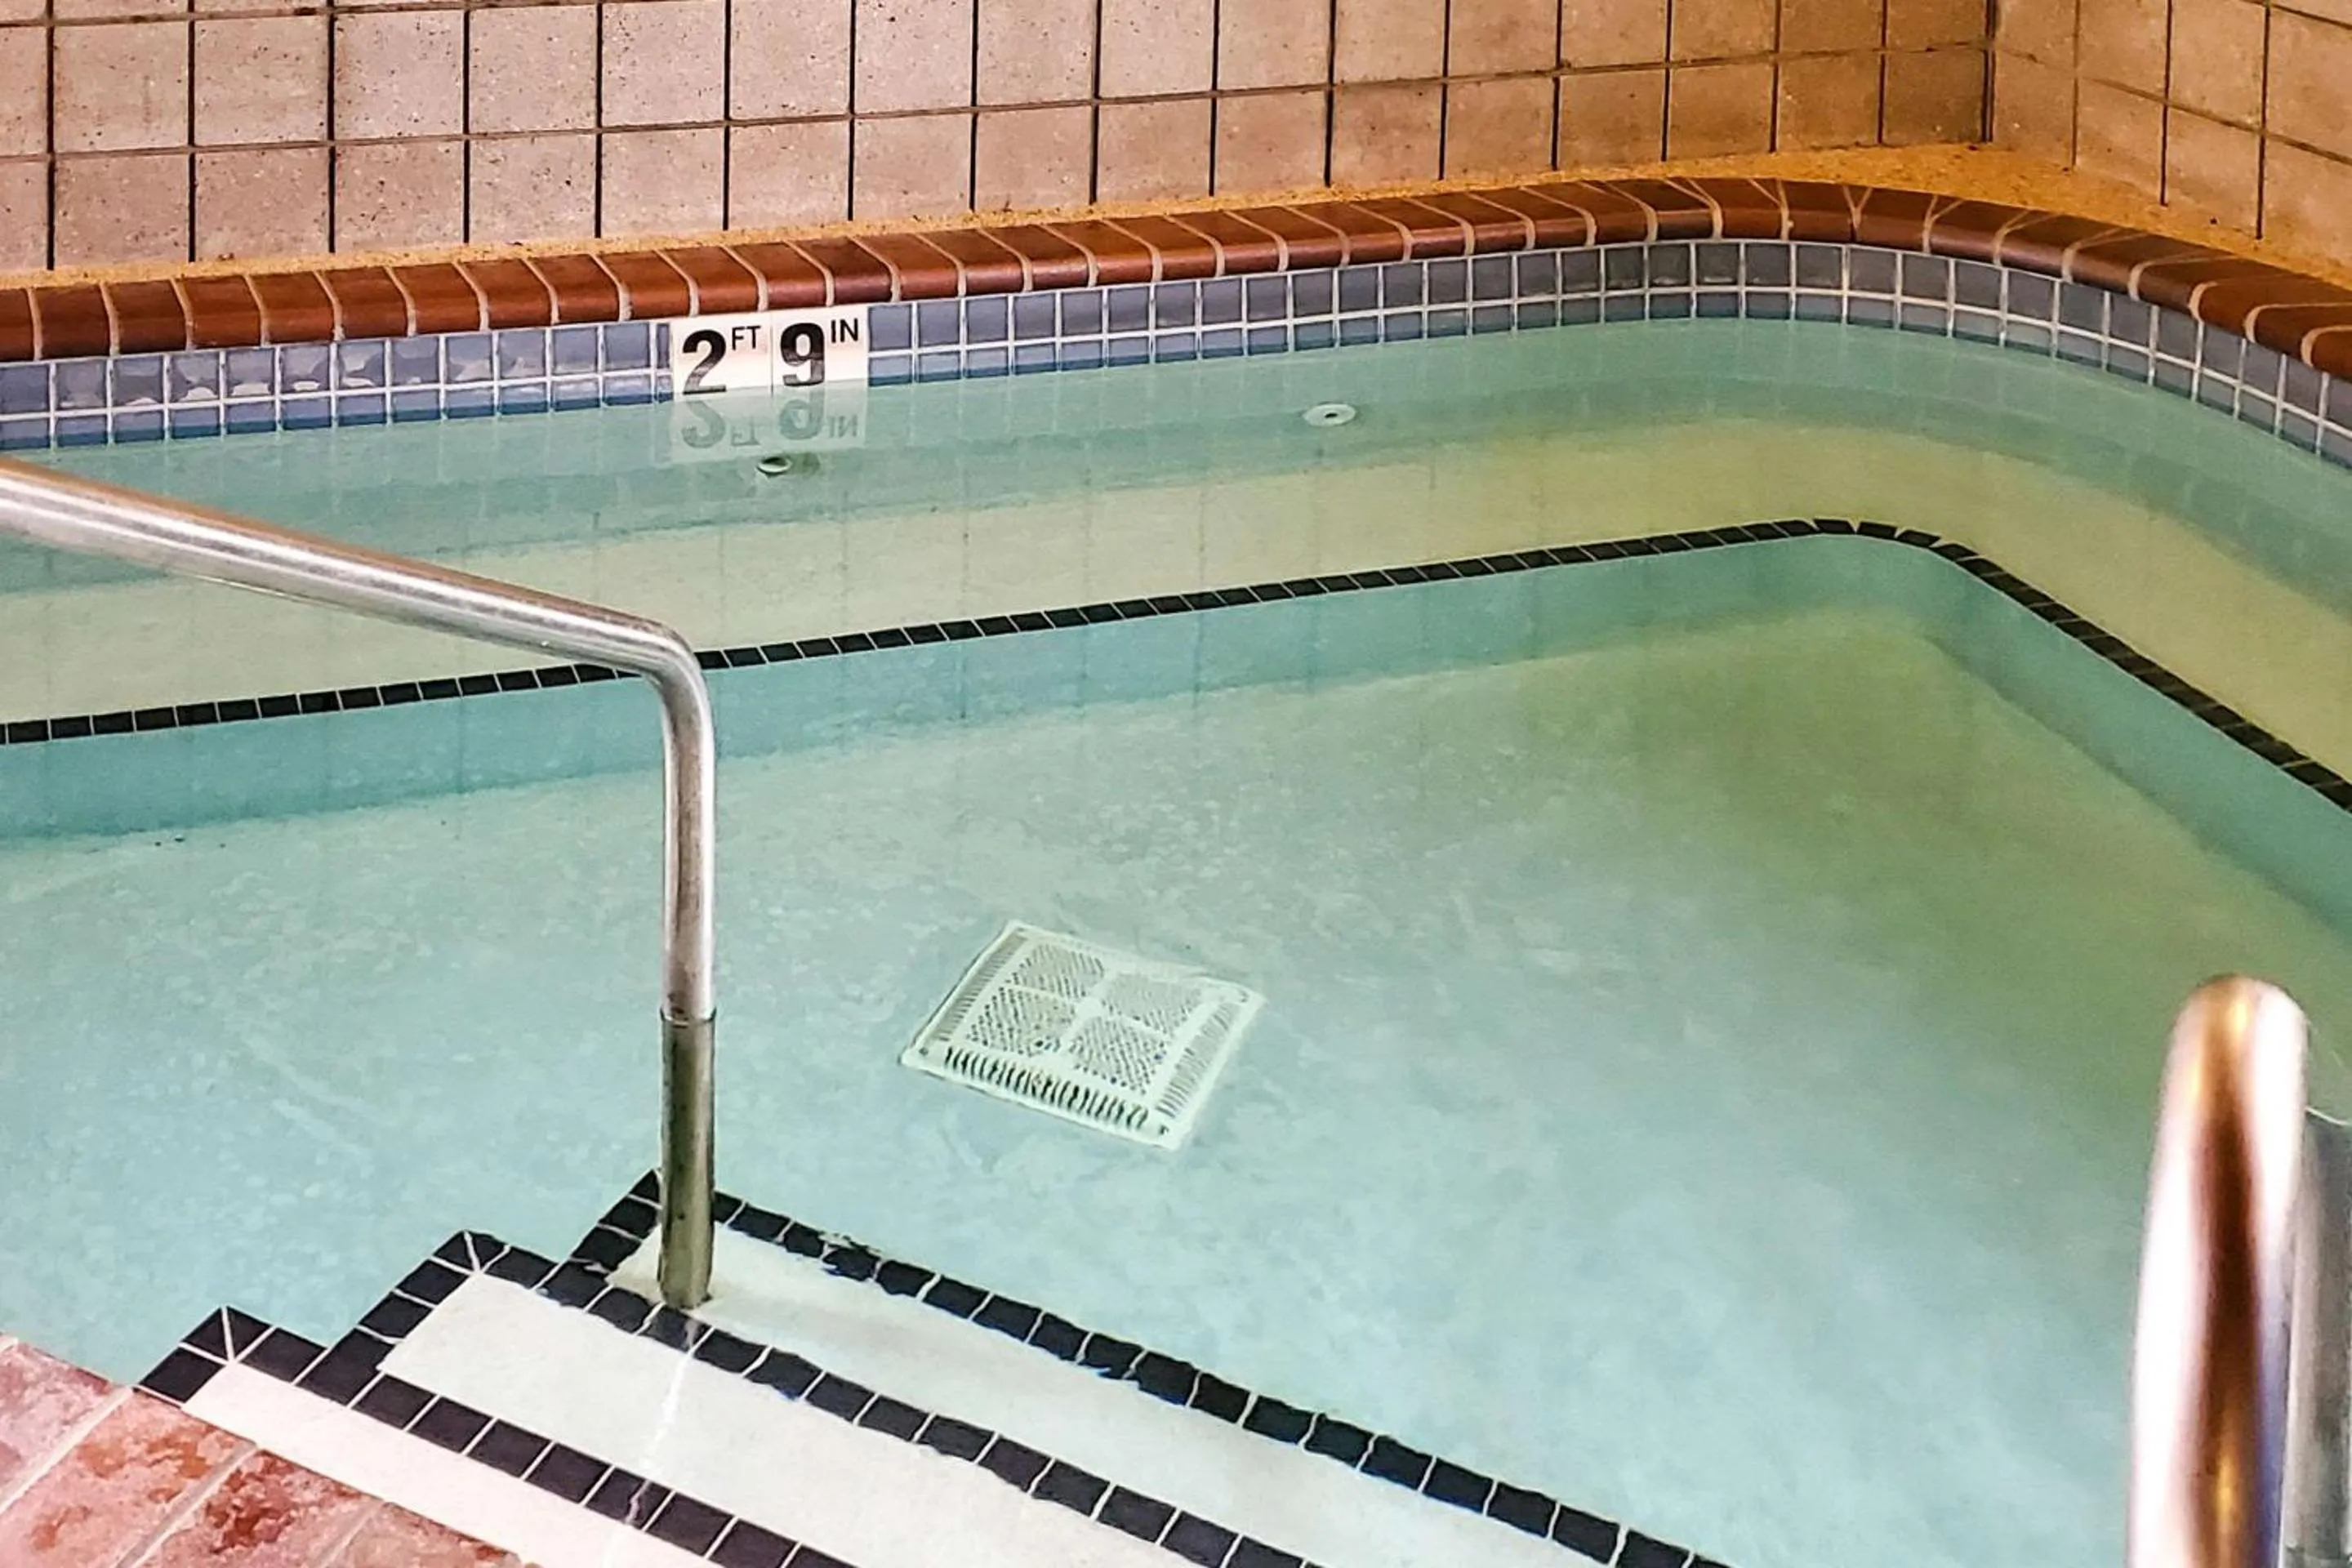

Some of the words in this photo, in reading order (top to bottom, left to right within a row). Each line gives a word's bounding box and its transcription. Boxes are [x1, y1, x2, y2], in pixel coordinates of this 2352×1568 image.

[682, 329, 727, 395] 2
[732, 325, 761, 350] FT
[780, 322, 825, 387] 9
[831, 318, 858, 343] IN
